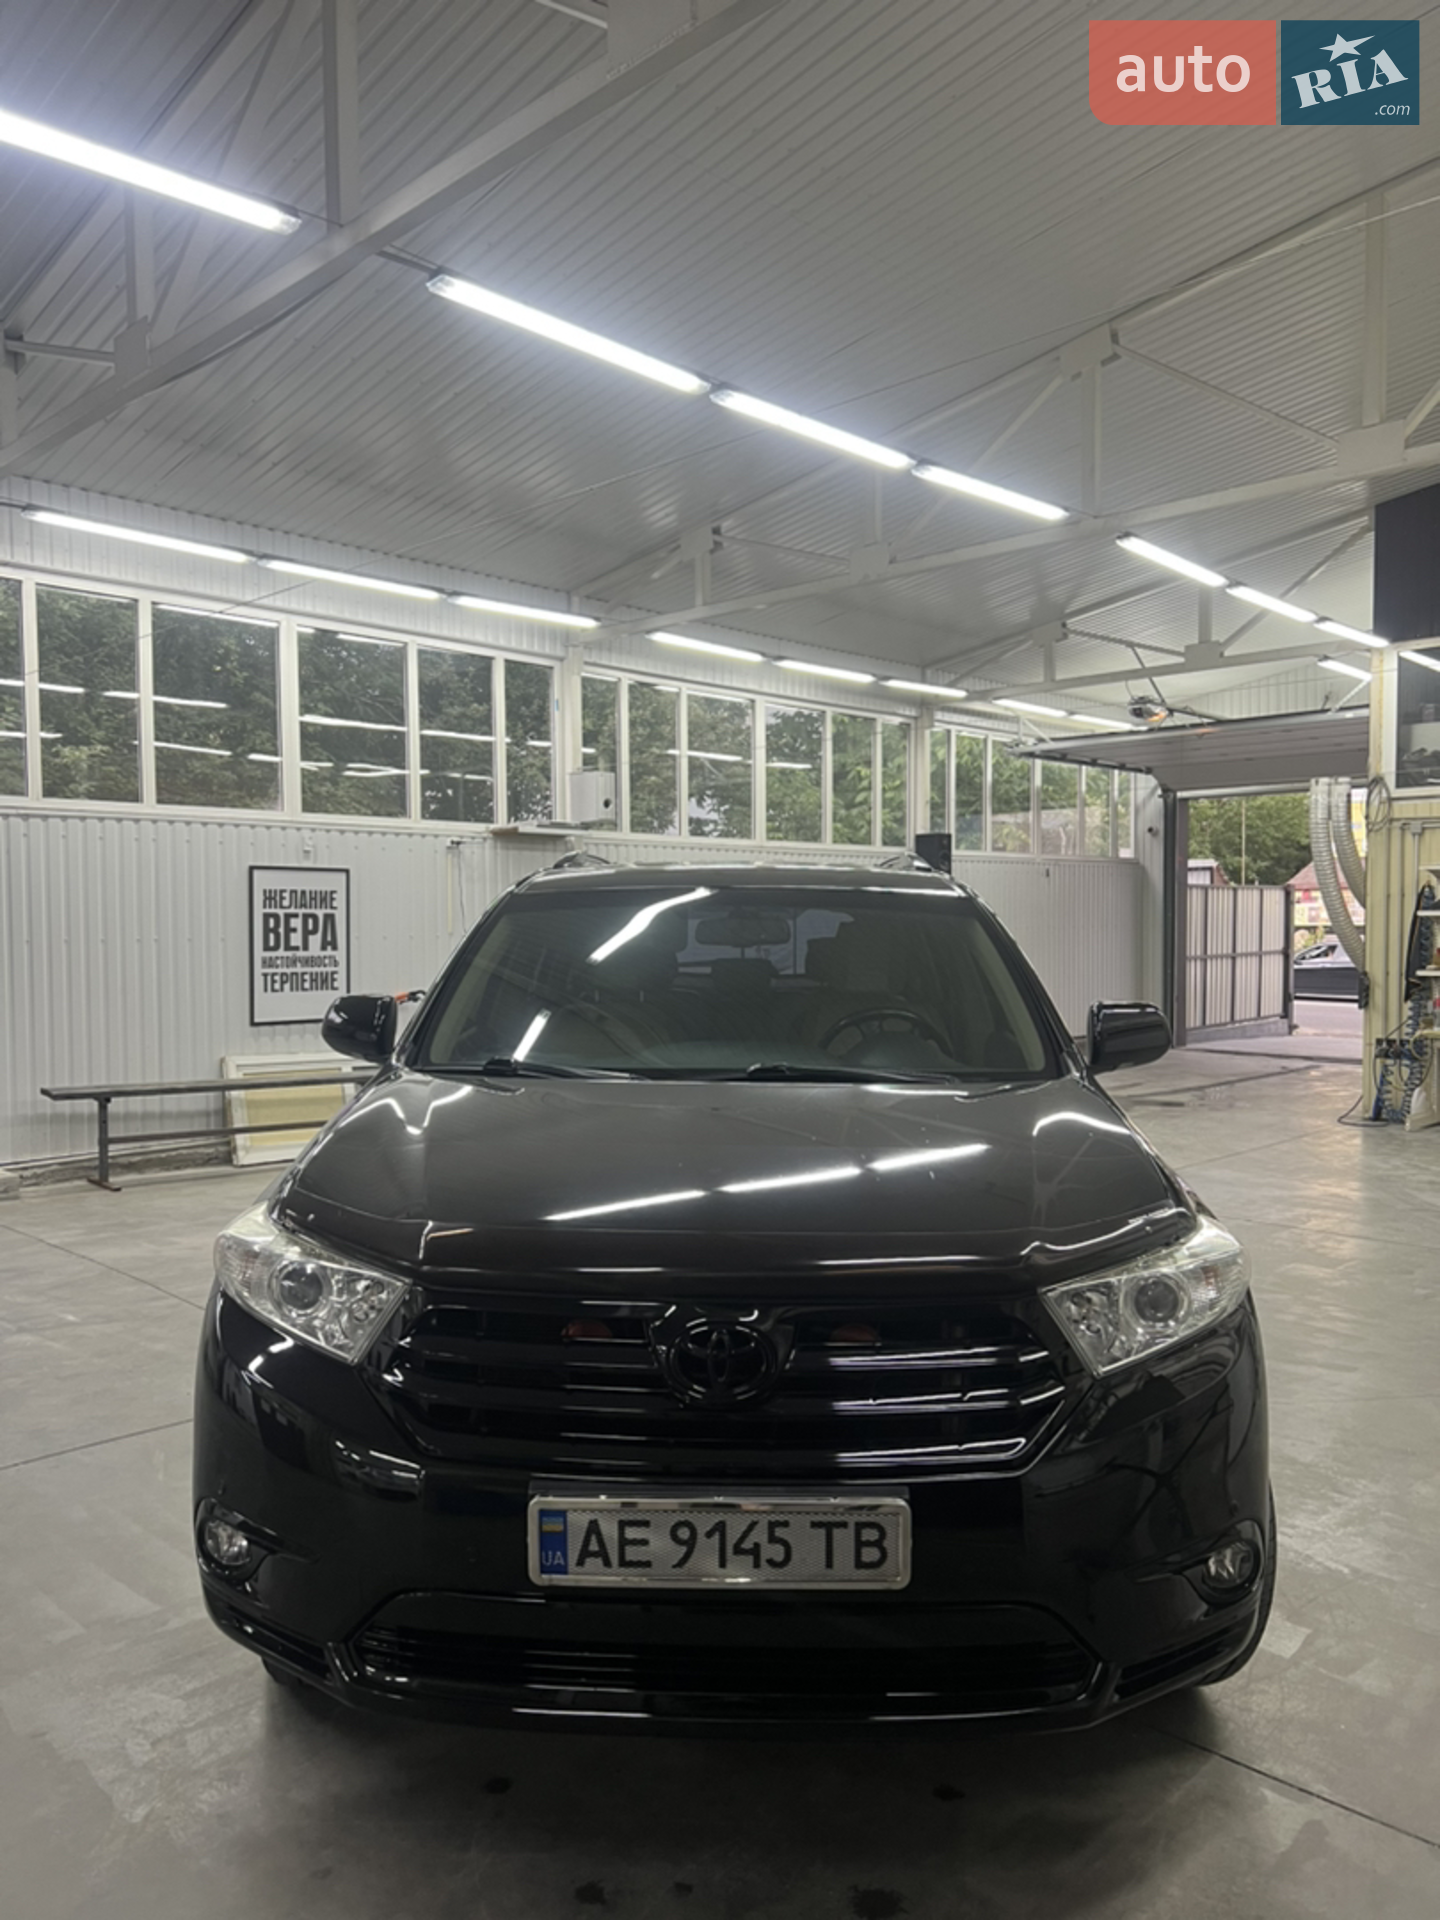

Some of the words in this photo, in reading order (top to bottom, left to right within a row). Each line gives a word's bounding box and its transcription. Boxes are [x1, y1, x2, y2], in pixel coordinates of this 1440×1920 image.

[262, 889, 338, 910] ЖЕЛАНИЕ
[262, 912, 338, 952] ВЕРА
[261, 953, 339, 969] НАСТОЙЧИВОСТЬ
[261, 971, 339, 993] ТЕРПЕНИЕ
[575, 1518, 652, 1569] AE
[669, 1519, 792, 1569] 9145
[810, 1520, 888, 1570] TB
[541, 1551, 565, 1565] UA
